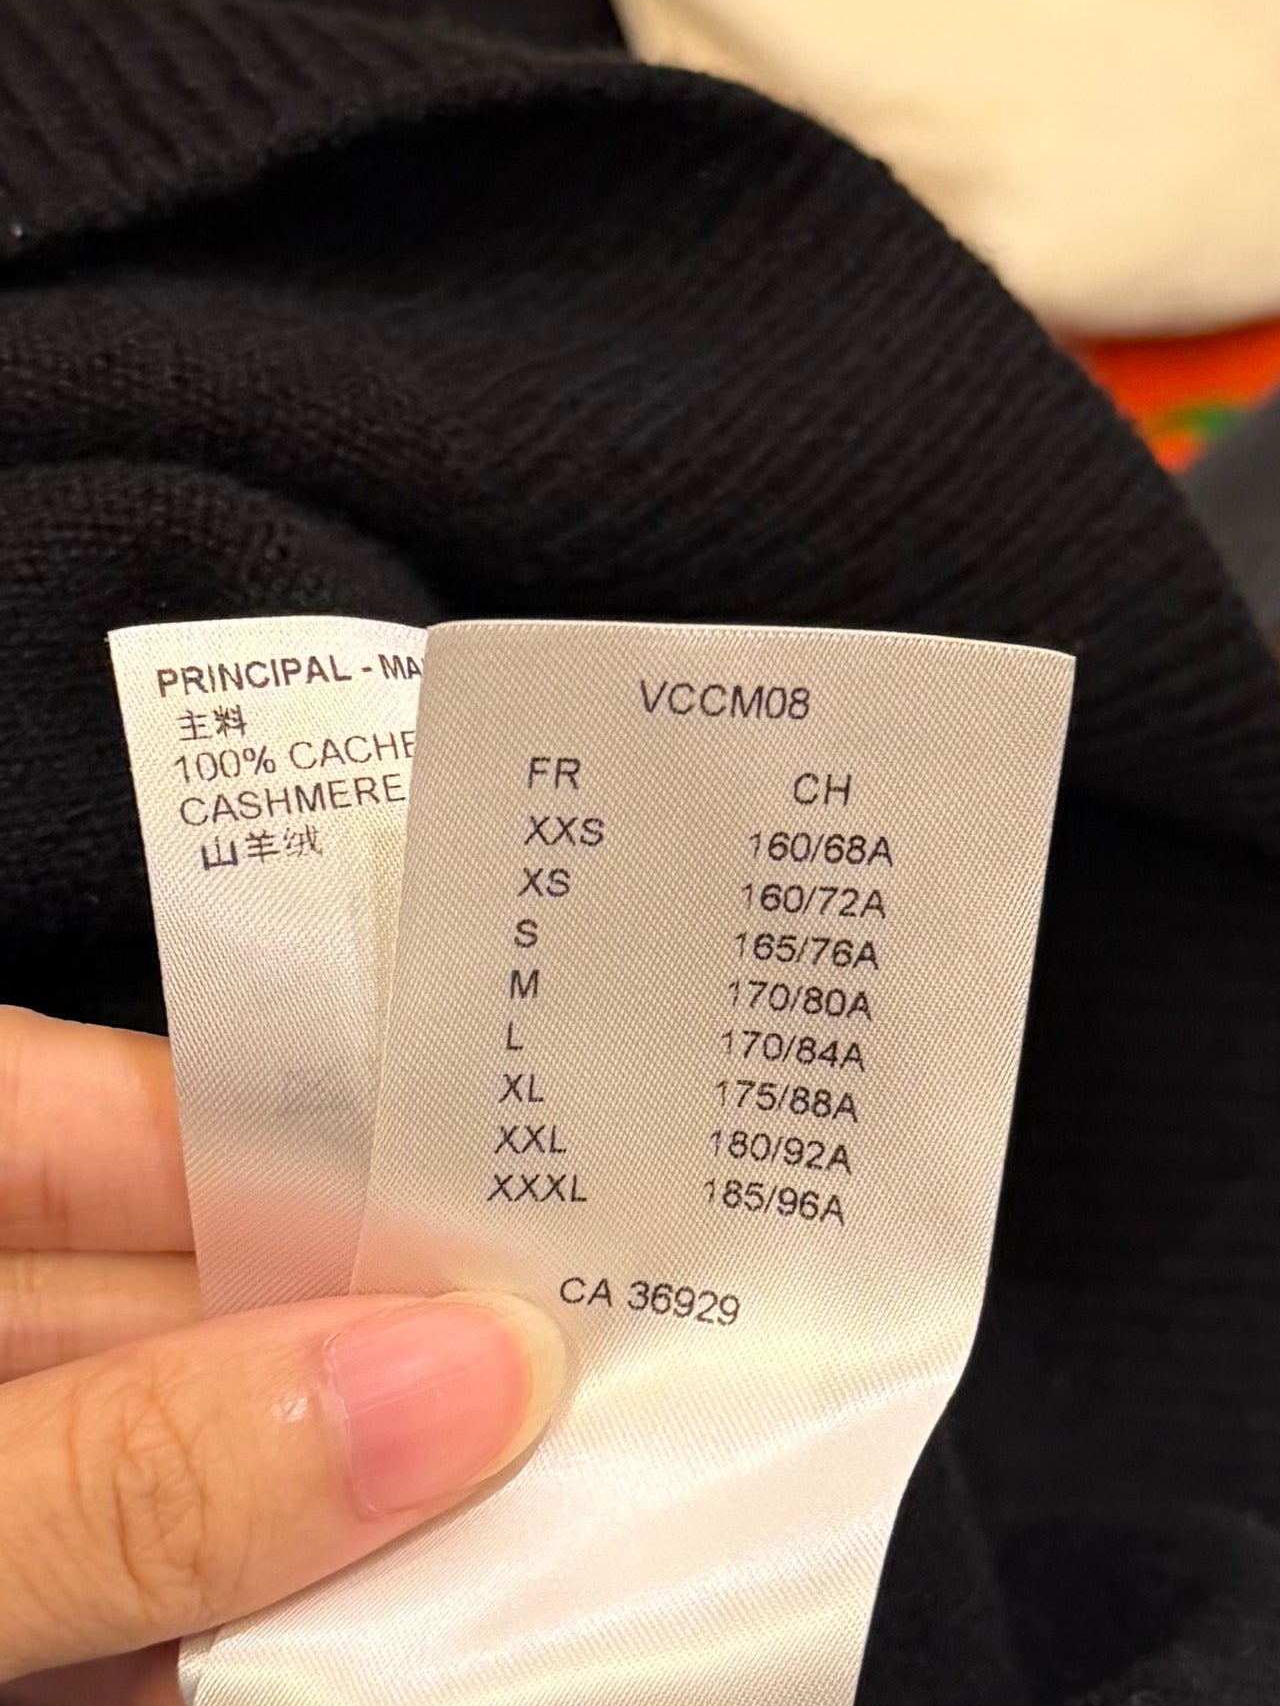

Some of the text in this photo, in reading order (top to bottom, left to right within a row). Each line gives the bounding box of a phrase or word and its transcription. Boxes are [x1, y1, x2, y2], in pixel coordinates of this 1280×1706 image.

[156, 654, 352, 698] PRINCIPAL
[378, 654, 424, 679] MA
[640, 679, 811, 720] VCCM08
[176, 704, 247, 742] 主料
[174, 745, 277, 784] 100%
[527, 756, 853, 806] FR CH
[179, 773, 406, 826] CASHMERE
[200, 824, 323, 871] 山羊绒
[524, 816, 893, 867] XXS 160/68A
[517, 867, 886, 919] XS 160/72A
[514, 919, 879, 969] S 165/76A
[510, 969, 872, 1021] M 170/80A
[506, 1022, 865, 1072] L 170/84A
[499, 1073, 858, 1123] XL 175/88A
[494, 1125, 852, 1175] XXL 180/92A
[487, 1174, 845, 1227] XXXL 185/96A
[560, 1277, 741, 1326] CA 36929
